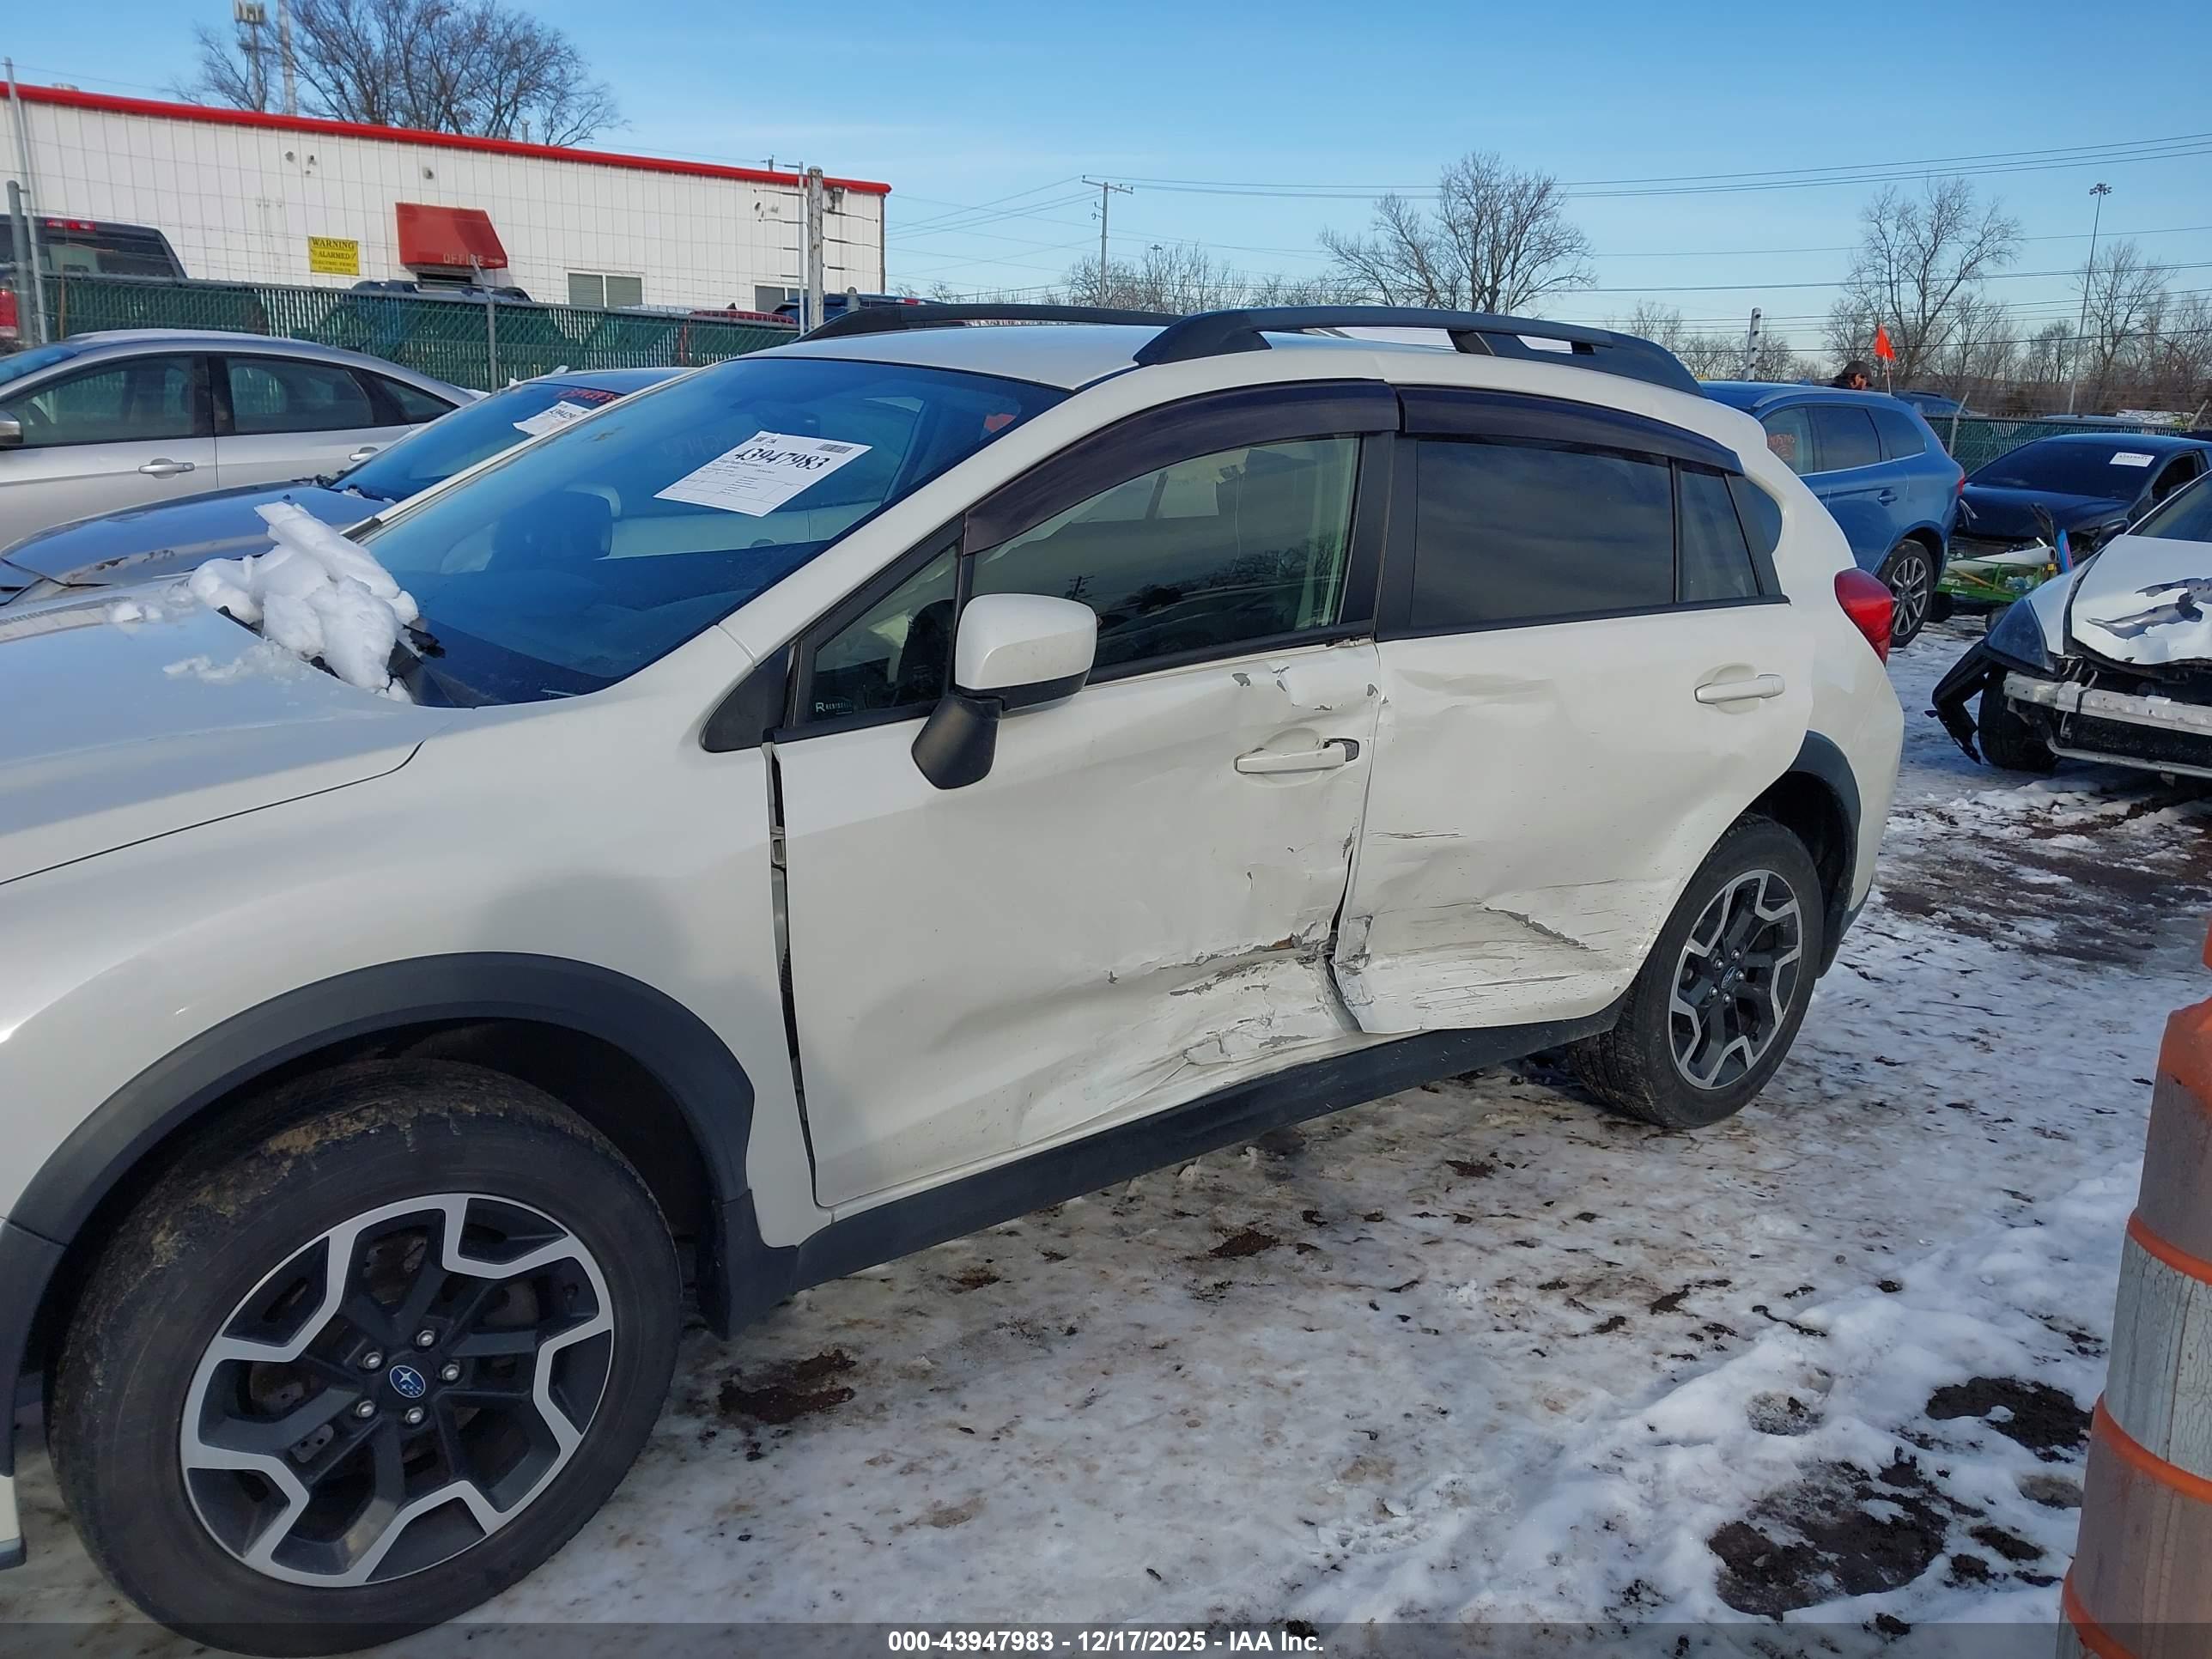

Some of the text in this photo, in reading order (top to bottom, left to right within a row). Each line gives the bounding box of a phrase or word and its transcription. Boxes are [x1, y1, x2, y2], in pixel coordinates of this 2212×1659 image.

[311, 238, 355, 250] WARNING
[318, 251, 350, 259] ALARMED
[734, 447, 831, 471] 43947983
